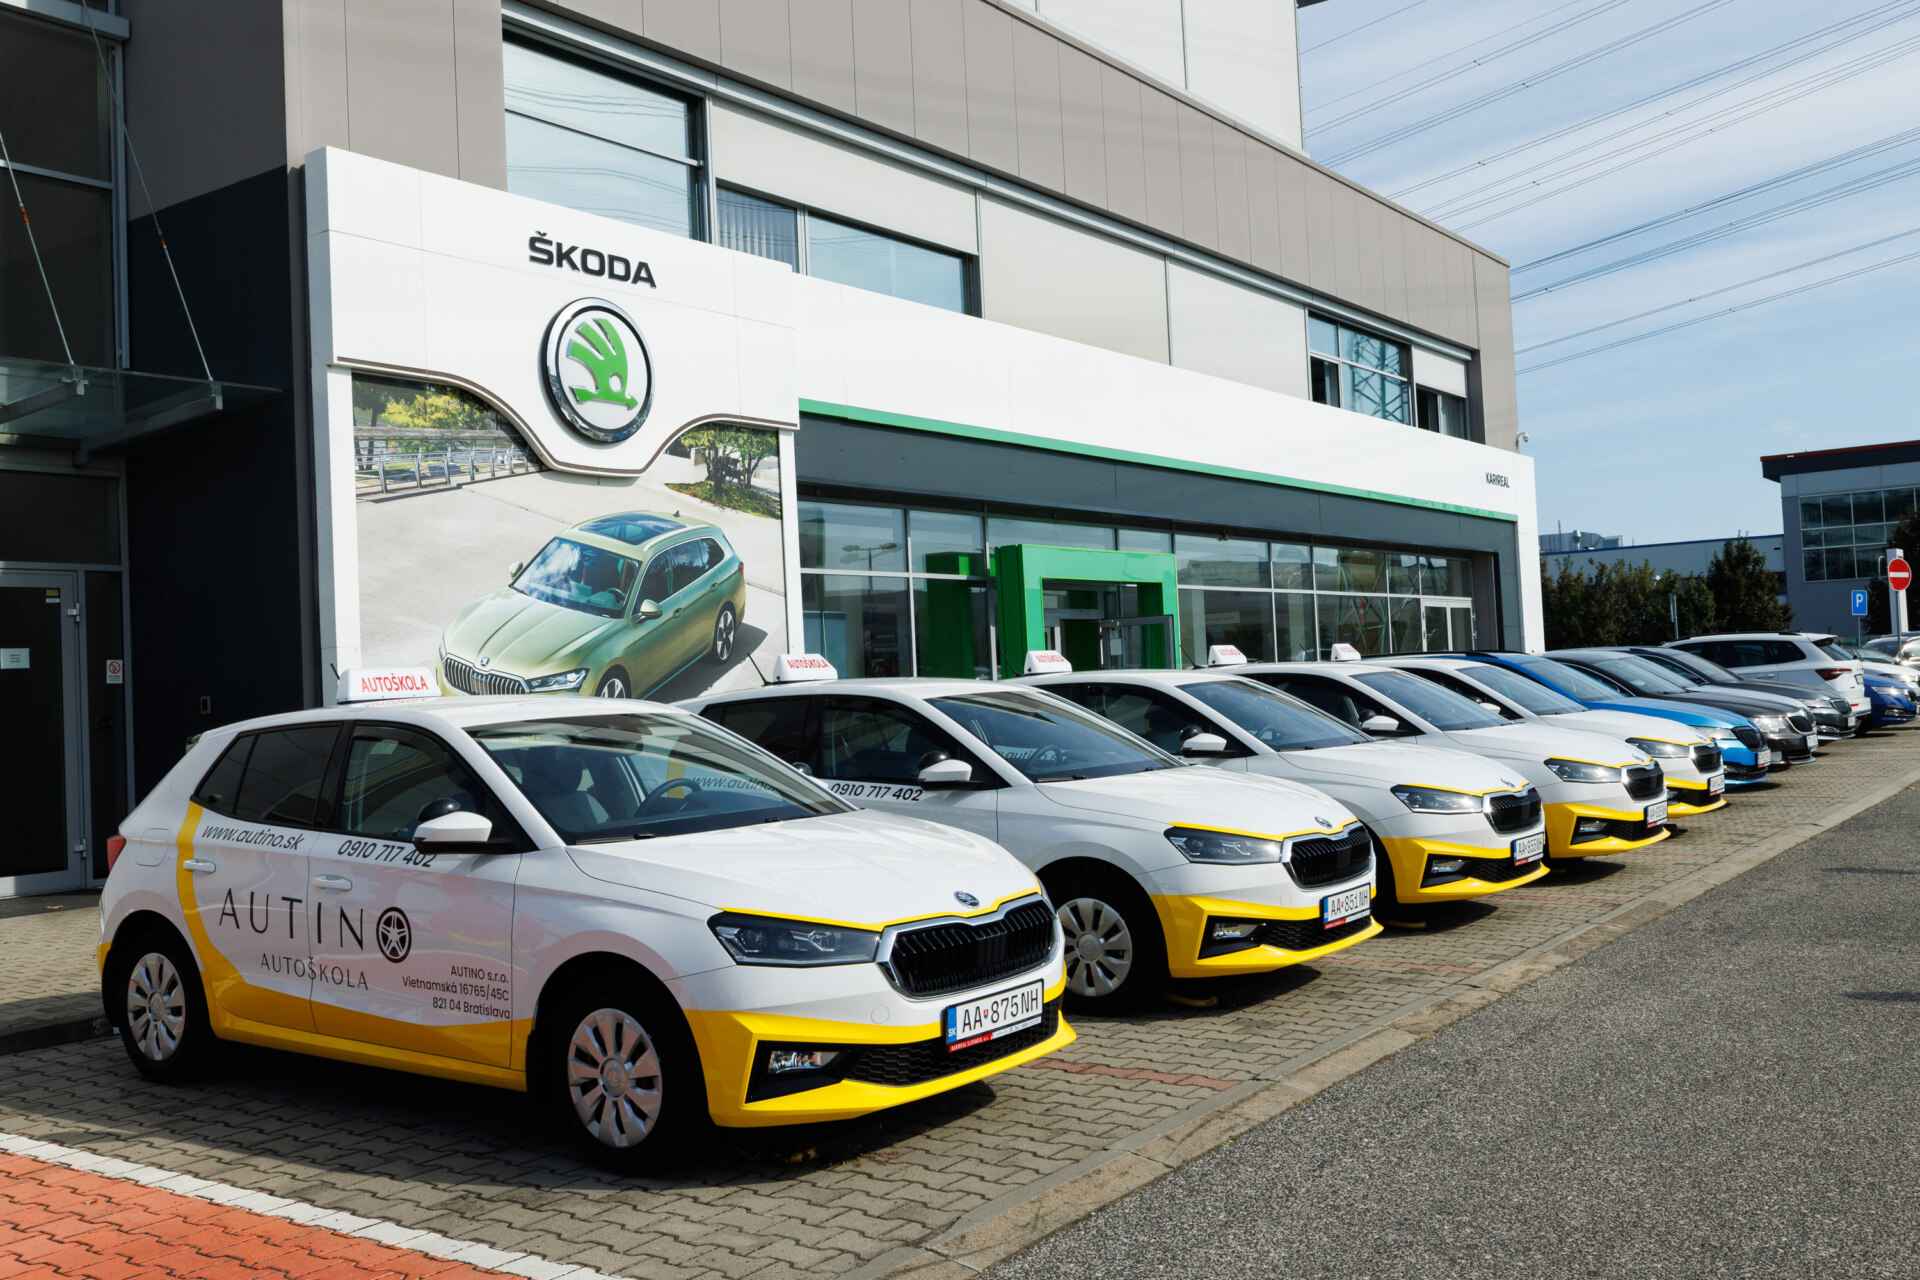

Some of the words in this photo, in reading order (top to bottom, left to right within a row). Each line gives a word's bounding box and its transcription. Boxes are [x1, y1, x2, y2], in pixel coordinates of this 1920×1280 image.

[529, 231, 657, 289] ŠKODA
[1856, 593, 1864, 609] P
[361, 672, 429, 693] AUTOŠKOLA
[830, 782, 864, 797] 0910
[866, 784, 890, 799] 717
[892, 786, 925, 802] 402
[201, 824, 304, 851] www.autino.sk
[336, 839, 371, 859] 0910
[375, 843, 405, 863] 717
[260, 952, 369, 991] AUTOŠKOLA
[450, 965, 486, 980] AUTINO
[487, 971, 509, 983] s.r.o.
[402, 976, 458, 994] Vietnamská
[460, 983, 509, 1001] 16765/45C
[432, 997, 447, 1009] 821
[449, 999, 461, 1011] 04
[463, 1001, 511, 1019] Bratislava
